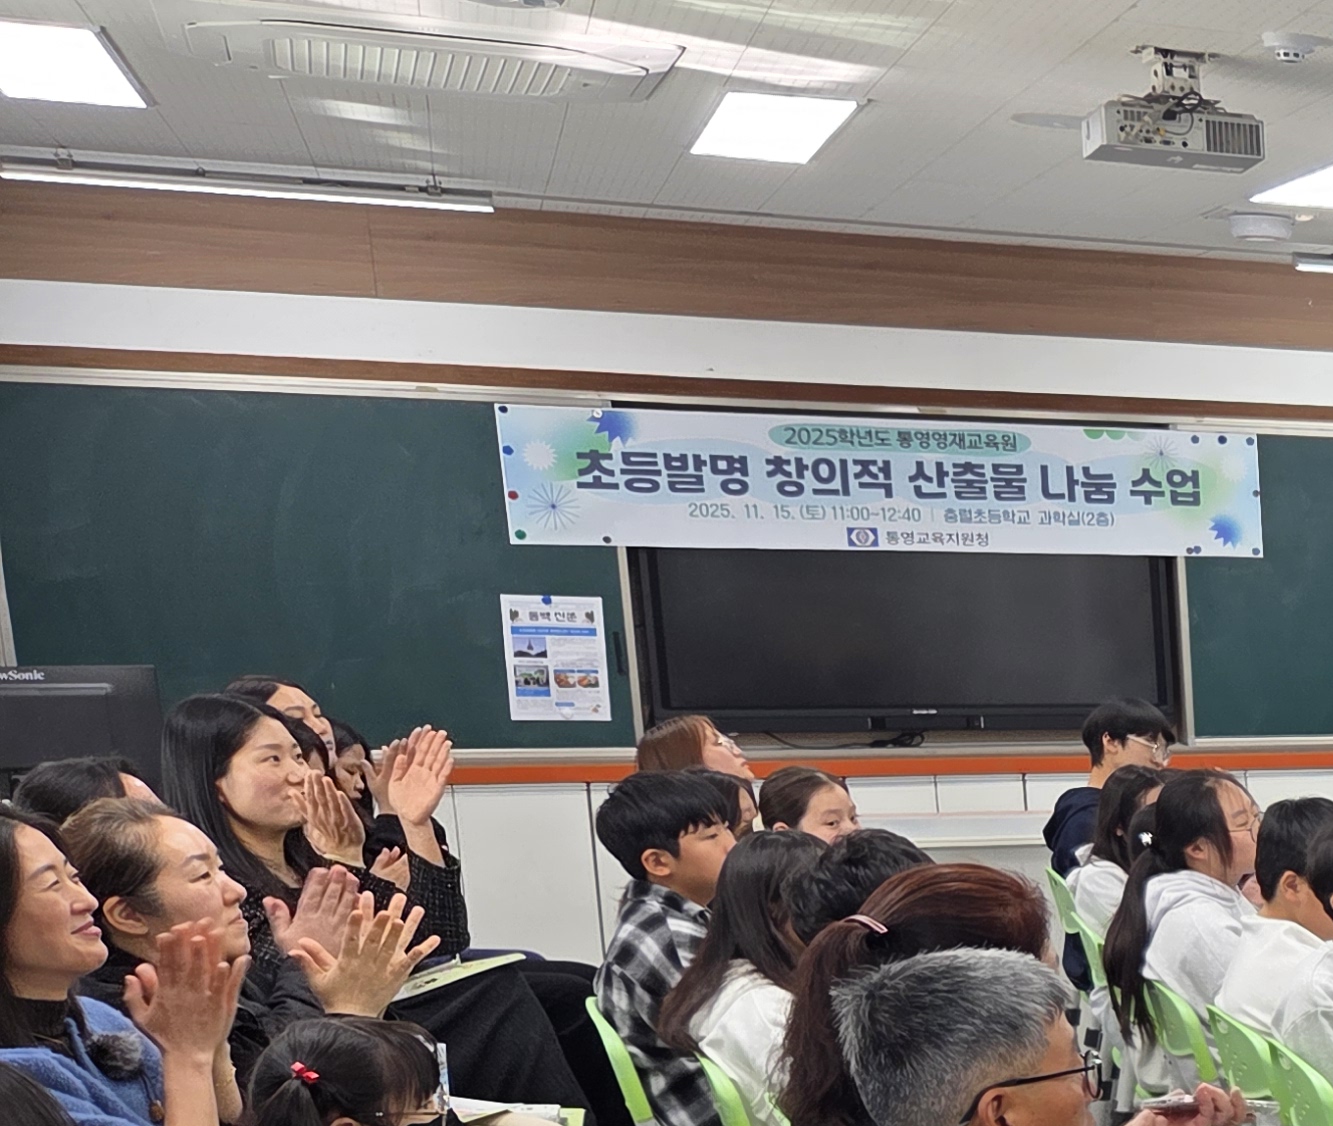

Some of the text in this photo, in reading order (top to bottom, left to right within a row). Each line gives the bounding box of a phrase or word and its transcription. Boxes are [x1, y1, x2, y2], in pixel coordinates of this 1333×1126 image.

[784, 426, 1018, 452] 2025학년도 통영영재교육원
[576, 450, 1201, 507] 초등발명 창의적 산출물 나눔 수업
[688, 503, 735, 518] 2025.
[744, 504, 764, 519] 11.
[774, 505, 795, 520] 15.
[800, 505, 826, 520] (토)
[885, 531, 989, 547] 통영교육지원청
